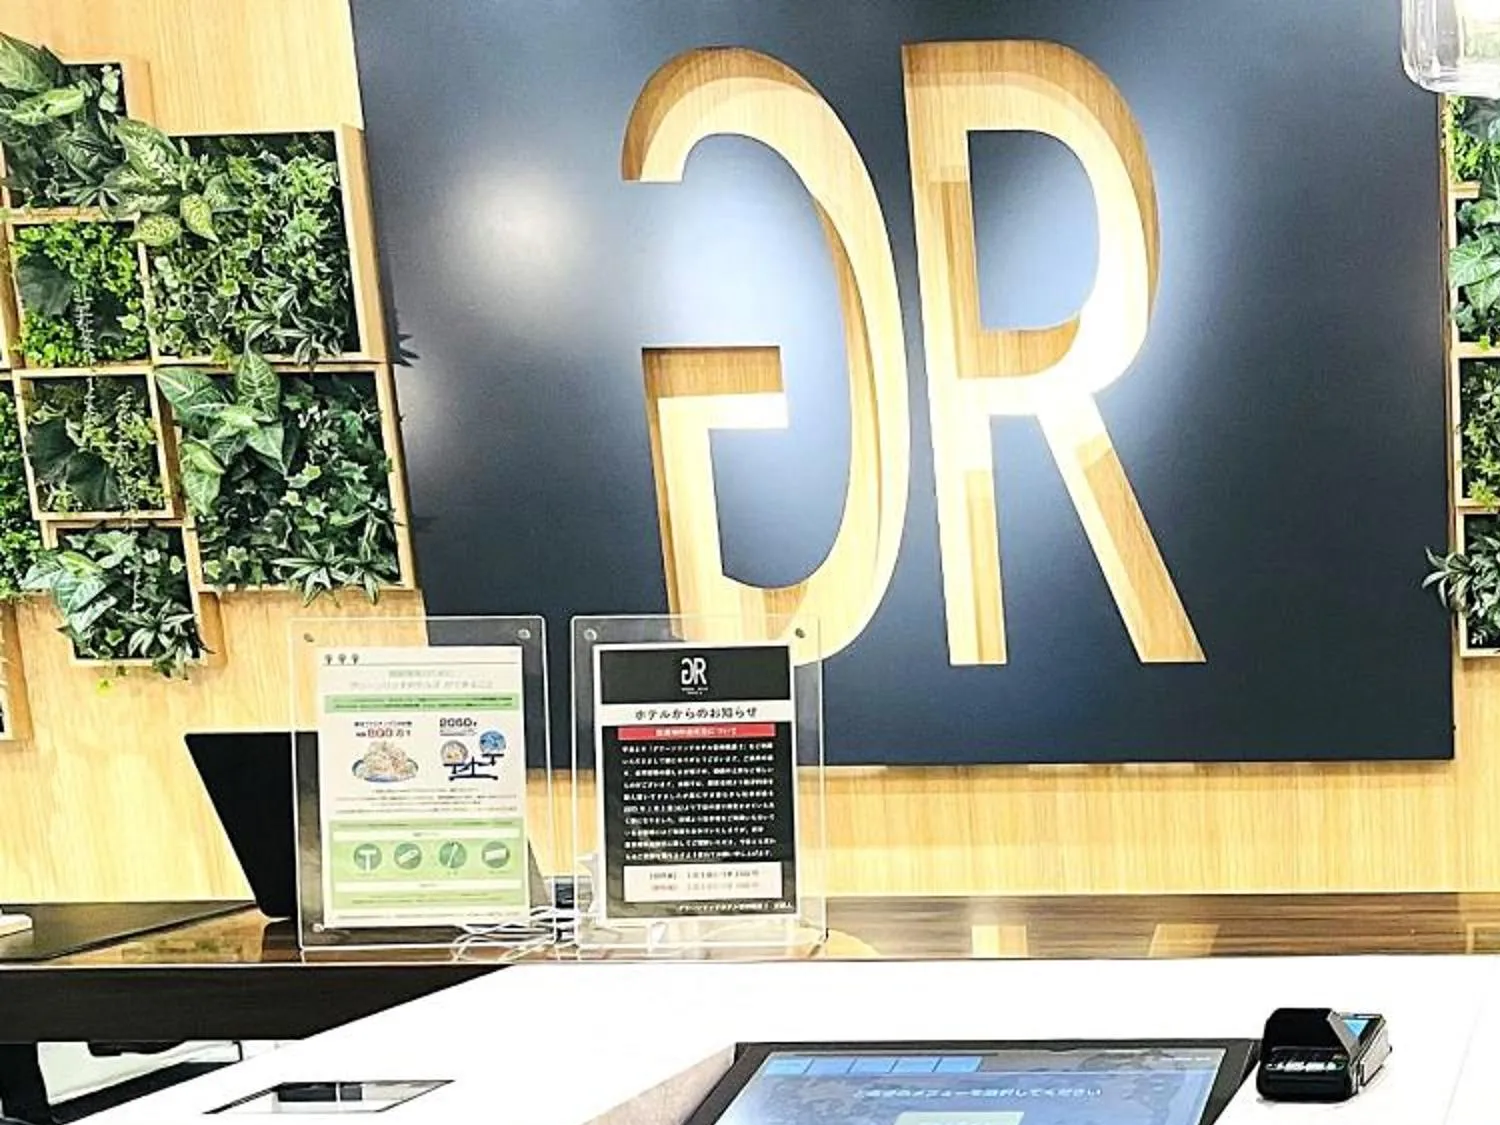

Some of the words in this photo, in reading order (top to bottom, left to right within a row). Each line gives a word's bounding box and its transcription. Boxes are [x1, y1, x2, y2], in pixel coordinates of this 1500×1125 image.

[635, 706, 758, 721] ホテルからのお知らせ
